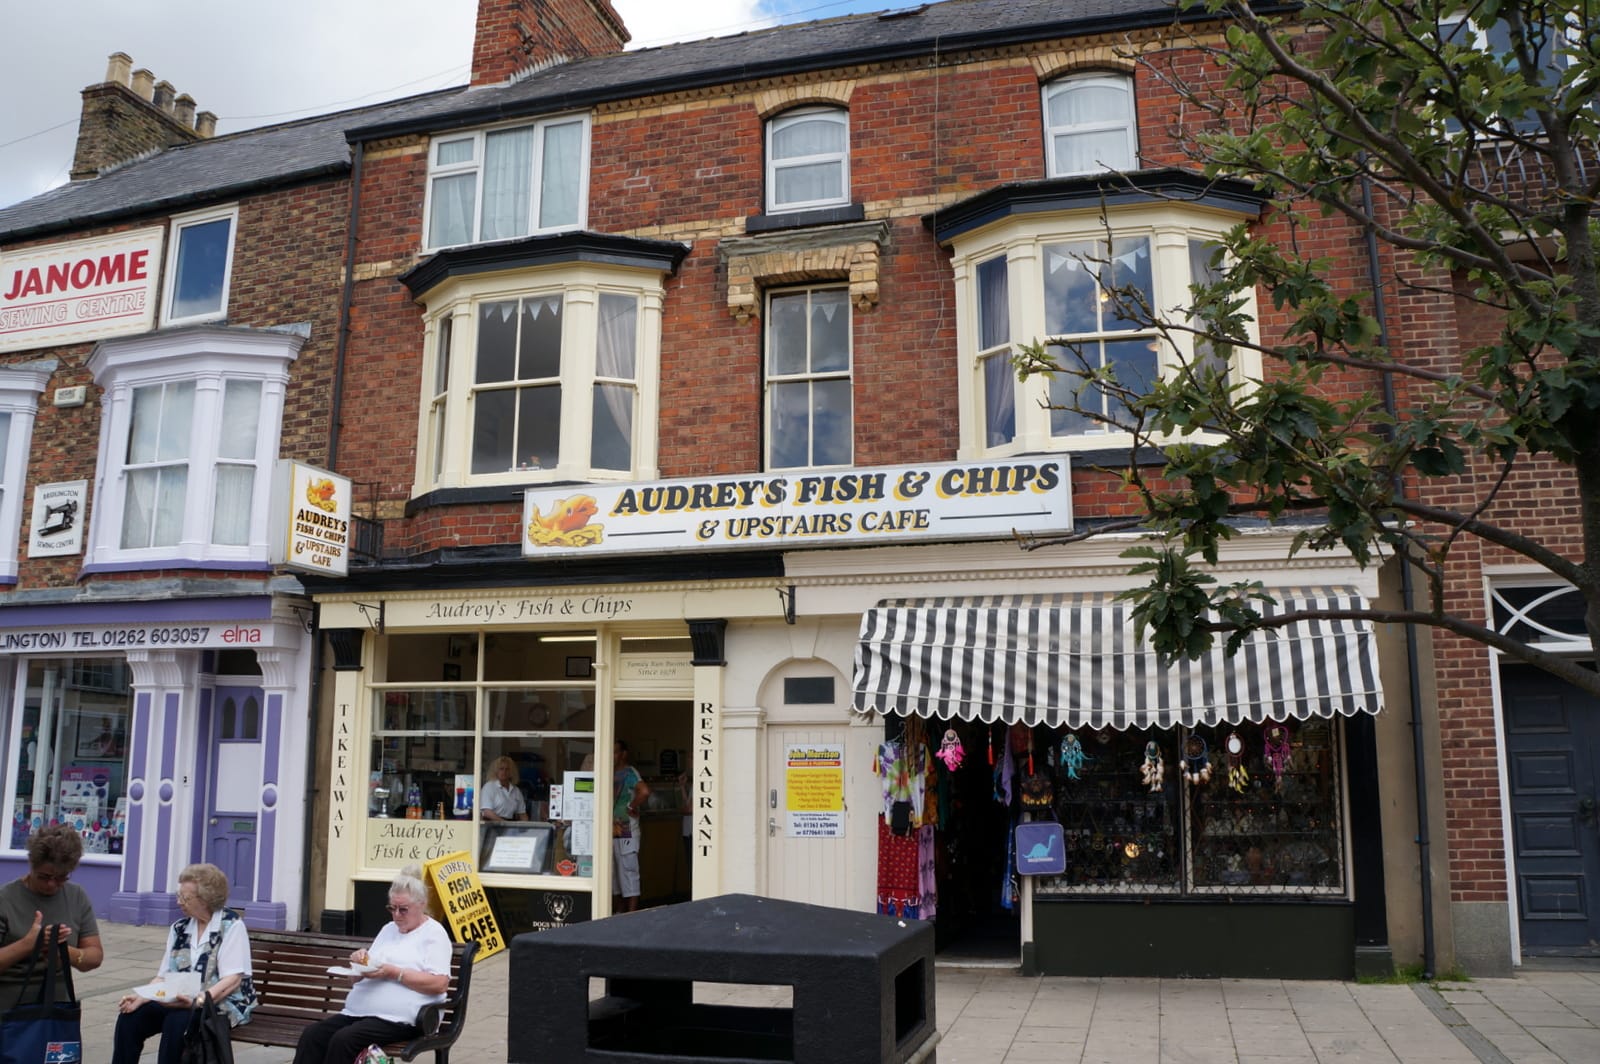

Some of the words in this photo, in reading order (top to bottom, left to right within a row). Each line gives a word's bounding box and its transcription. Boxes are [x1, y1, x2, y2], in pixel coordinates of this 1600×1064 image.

[4, 249, 149, 300] JANOME
[0, 303, 68, 329] SEWING
[76, 291, 146, 319] CENTRE
[43, 490, 79, 500] BRIDLINGTON
[607, 478, 788, 517] AUDREY'S
[792, 473, 887, 506] FISH
[893, 470, 931, 501] &
[936, 463, 1060, 499] CHIPS
[296, 522, 314, 535] FISH
[316, 528, 323, 537] &
[324, 530, 346, 543] CHIPS
[695, 519, 720, 542] &
[725, 512, 852, 540] UPSTAIRS
[857, 509, 931, 533] CAFE
[37, 540, 55, 549] SEWING
[55, 538, 74, 549] CENTRE
[295, 541, 305, 554] &
[306, 540, 341, 557] UPSTAIRS
[312, 554, 331, 566] CAFE
[426, 598, 507, 623] Audrey's
[513, 596, 554, 619] Fish
[560, 599, 575, 615] &
[581, 595, 633, 619] Chips
[151, 627, 210, 645] 603057
[220, 624, 262, 644] elna
[637, 667, 658, 676] Since
[333, 704, 349, 838] TAKEAWAY
[698, 702, 714, 857] RESTAURANT
[380, 821, 455, 845] Audrey's
[370, 842, 405, 861] Fish
[409, 846, 420, 860] &
[447, 875, 472, 896] FISH
[448, 900, 458, 914] &
[456, 889, 484, 911] CHIPS
[455, 915, 467, 925] AND
[467, 906, 489, 920] UPSTAIRS
[460, 914, 497, 944] CAFE
[485, 936, 498, 951] 50
